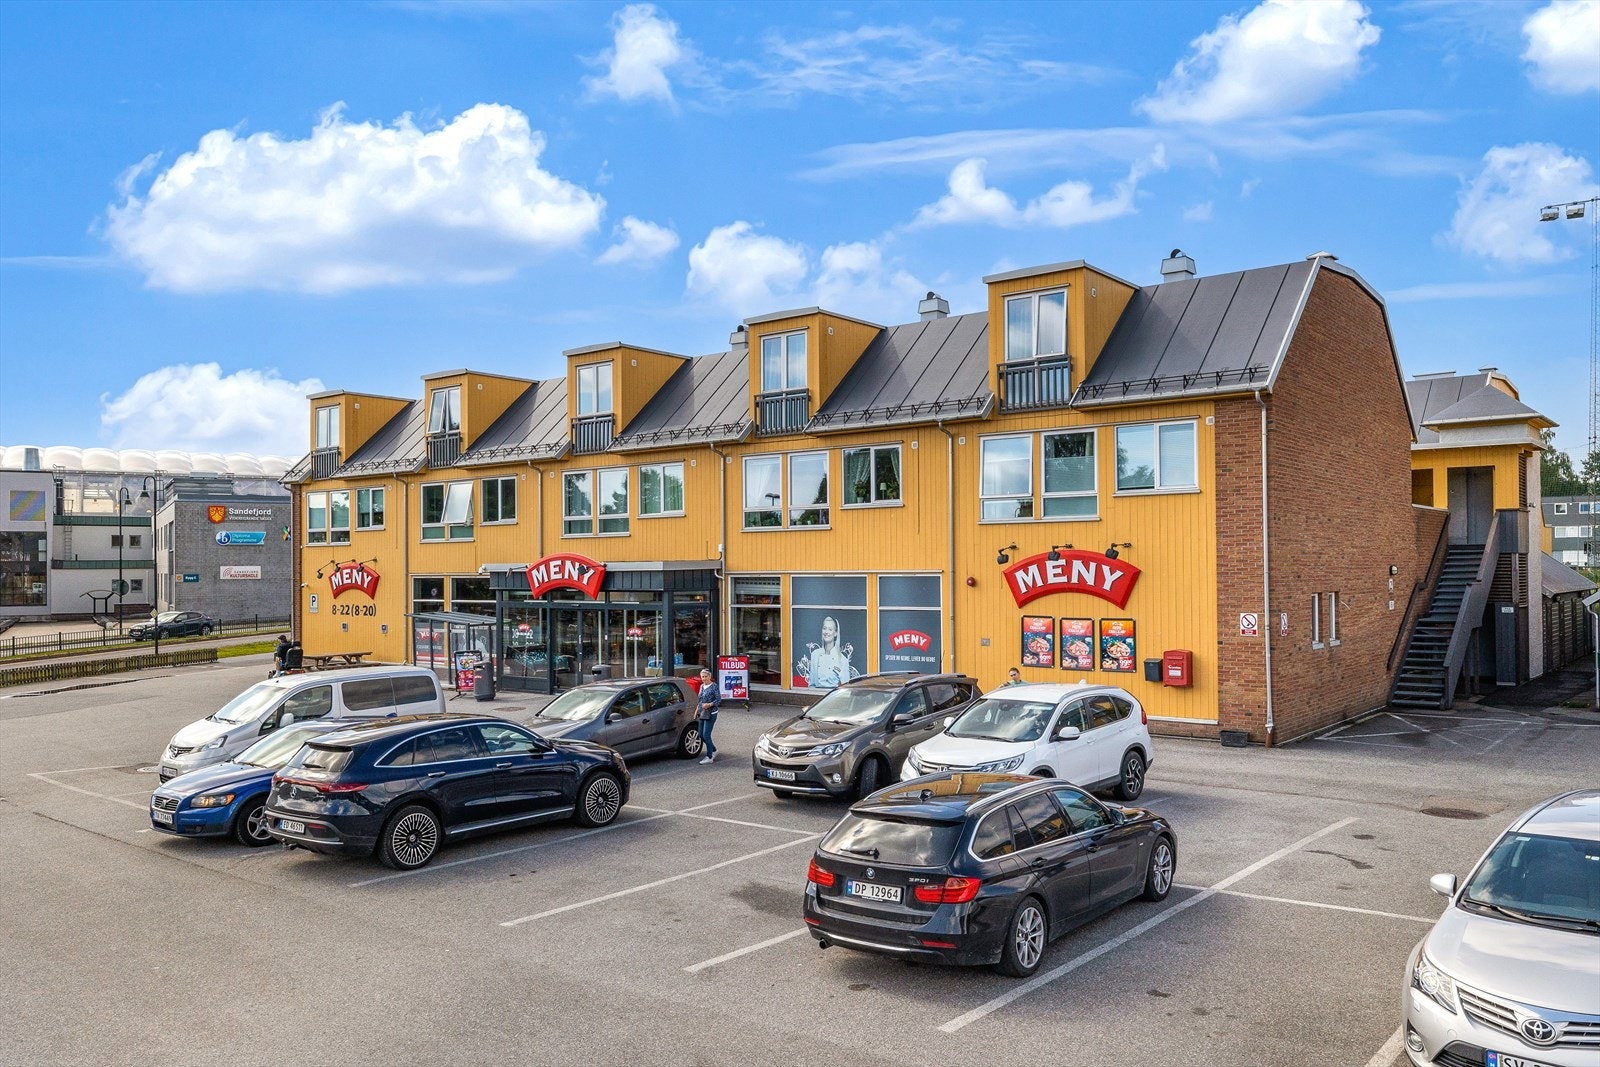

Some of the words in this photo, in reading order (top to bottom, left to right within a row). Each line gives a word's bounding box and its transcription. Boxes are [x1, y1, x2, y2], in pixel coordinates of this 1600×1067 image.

[228, 507, 272, 516] Sandefjord
[330, 568, 373, 590] MENY
[531, 559, 595, 588] MENY
[1013, 558, 1124, 594] MENY
[311, 595, 317, 606] P
[893, 634, 928, 646] MENY
[721, 661, 746, 669] TILBUD
[854, 883, 867, 894] DP
[871, 885, 899, 899] 12964
